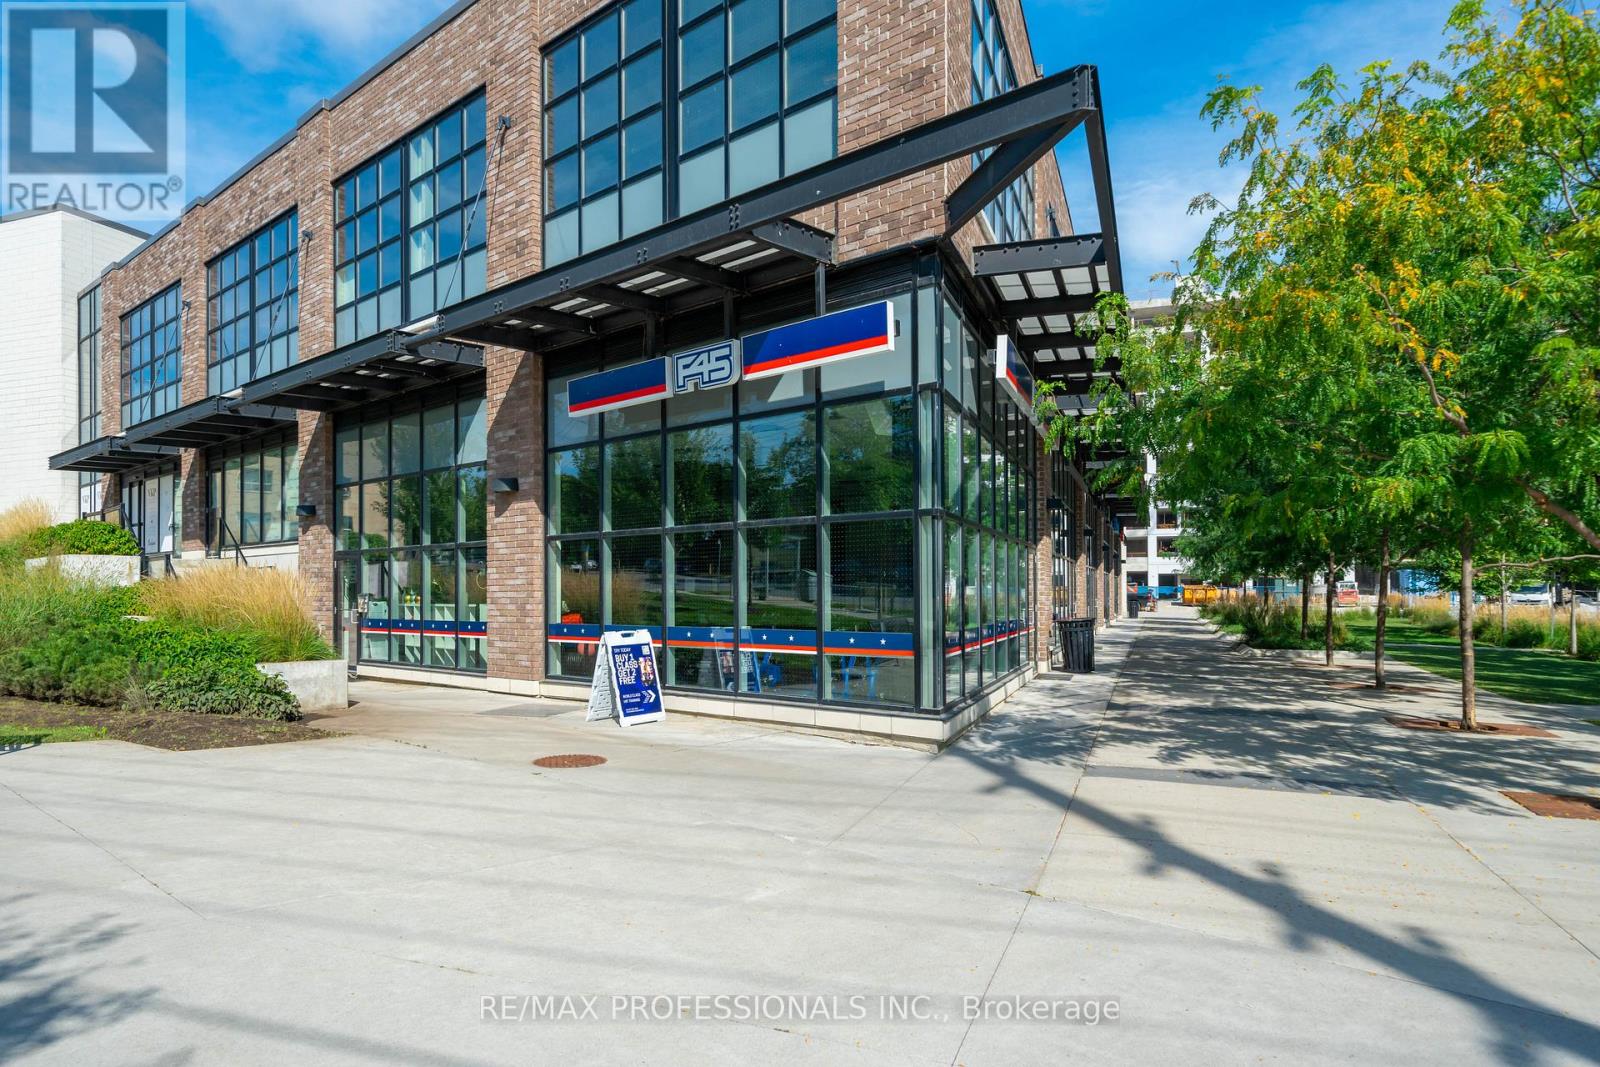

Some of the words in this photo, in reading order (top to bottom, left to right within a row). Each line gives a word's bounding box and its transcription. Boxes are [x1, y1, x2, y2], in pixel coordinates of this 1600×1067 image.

[676, 343, 732, 389] F45
[615, 654, 629, 663] BUY
[616, 661, 638, 670] CLASS
[618, 669, 630, 677] GET
[619, 677, 636, 685] FREE
